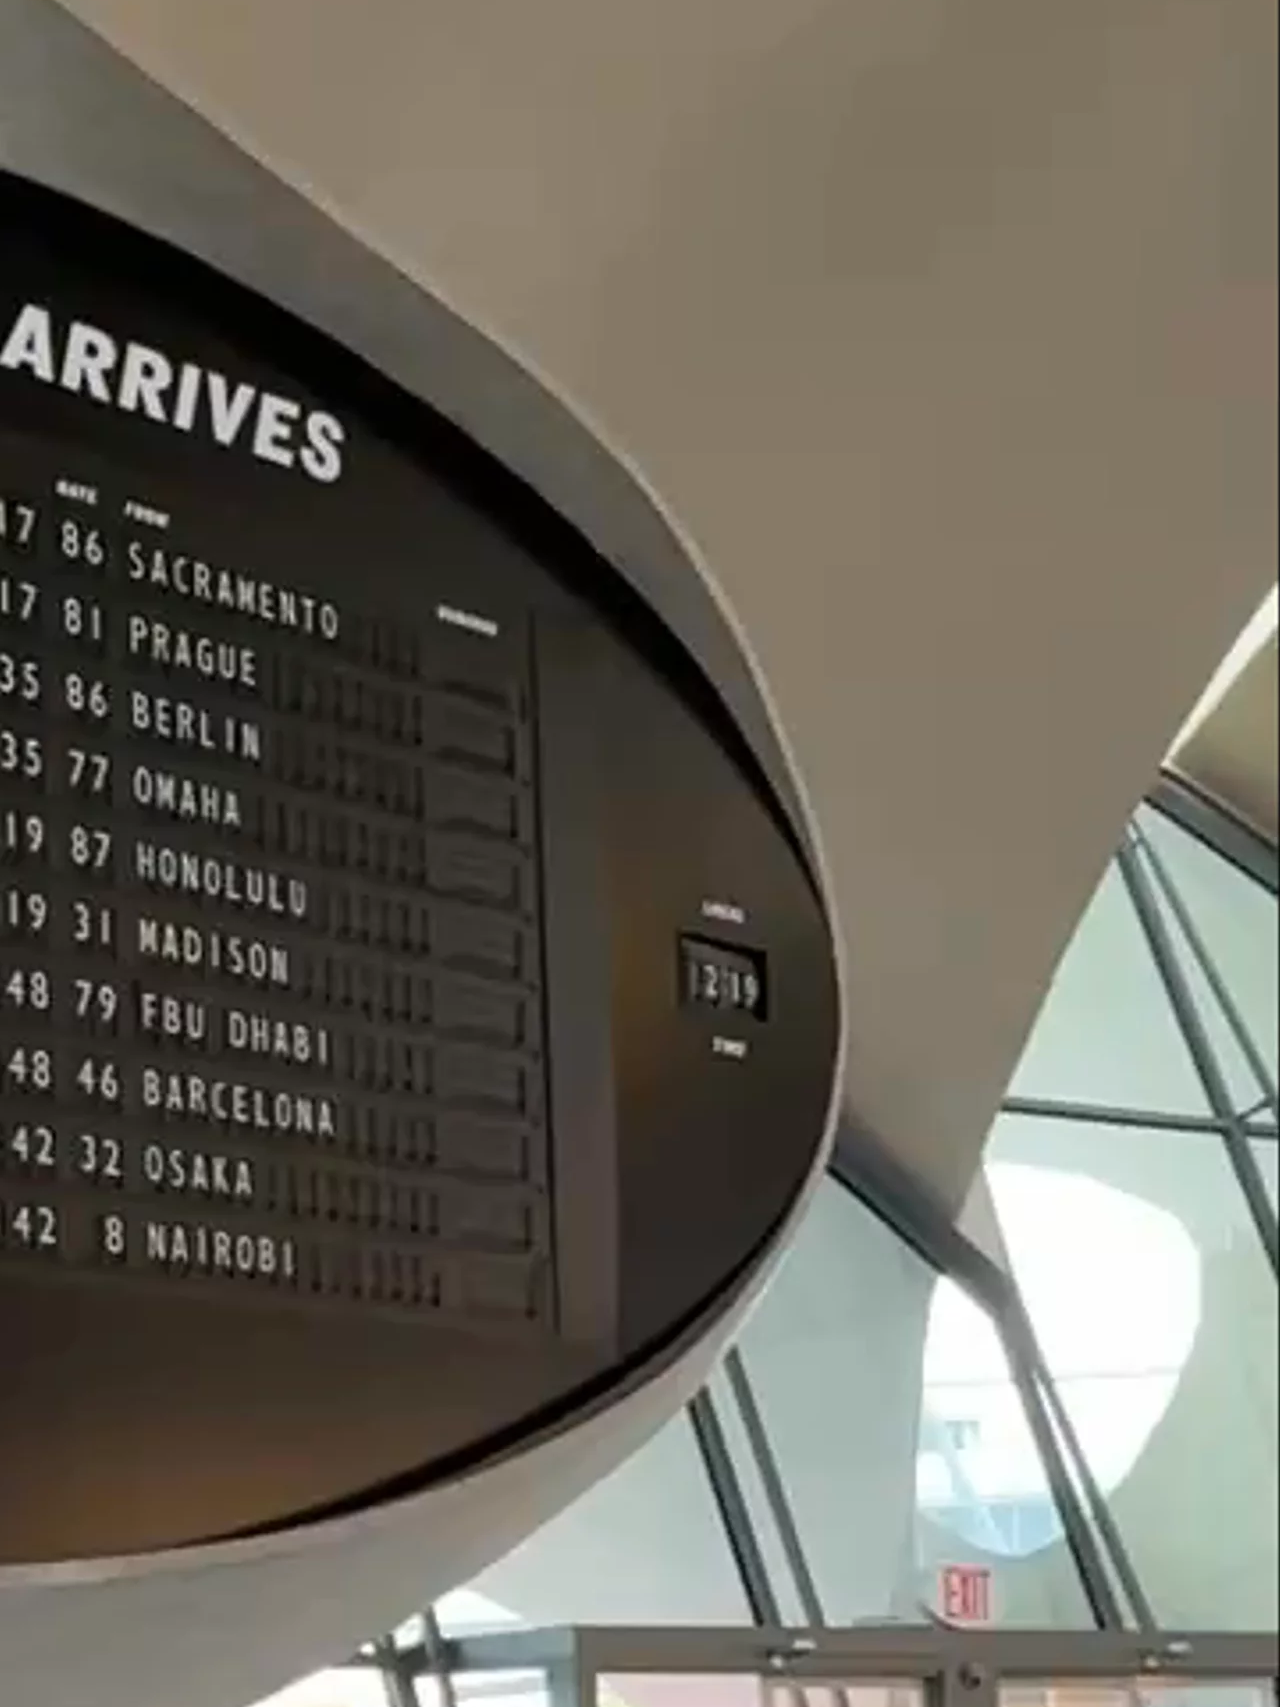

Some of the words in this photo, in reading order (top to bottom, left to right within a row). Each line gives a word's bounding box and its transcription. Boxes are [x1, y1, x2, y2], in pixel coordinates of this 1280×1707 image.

[61, 520, 103, 565] 86
[128, 541, 338, 641] SACRAMENTO
[63, 597, 100, 640] 81
[130, 616, 256, 686] PRAGUE
[65, 673, 108, 718] 86
[132, 690, 260, 760] BERLIN
[68, 748, 109, 791] 77
[133, 765, 241, 825] OMAHA
[70, 825, 111, 867] 87
[136, 841, 306, 917] HONOLULU
[74, 902, 110, 944] 31
[138, 918, 288, 983] MADISON
[75, 979, 117, 1021] 79
[229, 1011, 327, 1064] DHABI
[77, 1059, 118, 1100] 46
[143, 1068, 334, 1135] BARCELONA
[80, 1134, 121, 1177] 32
[144, 1145, 252, 1195] OSAKA
[104, 1215, 124, 1254] 8
[147, 1222, 293, 1276] NAIROBI
[944, 1571, 990, 1620] EXIT
